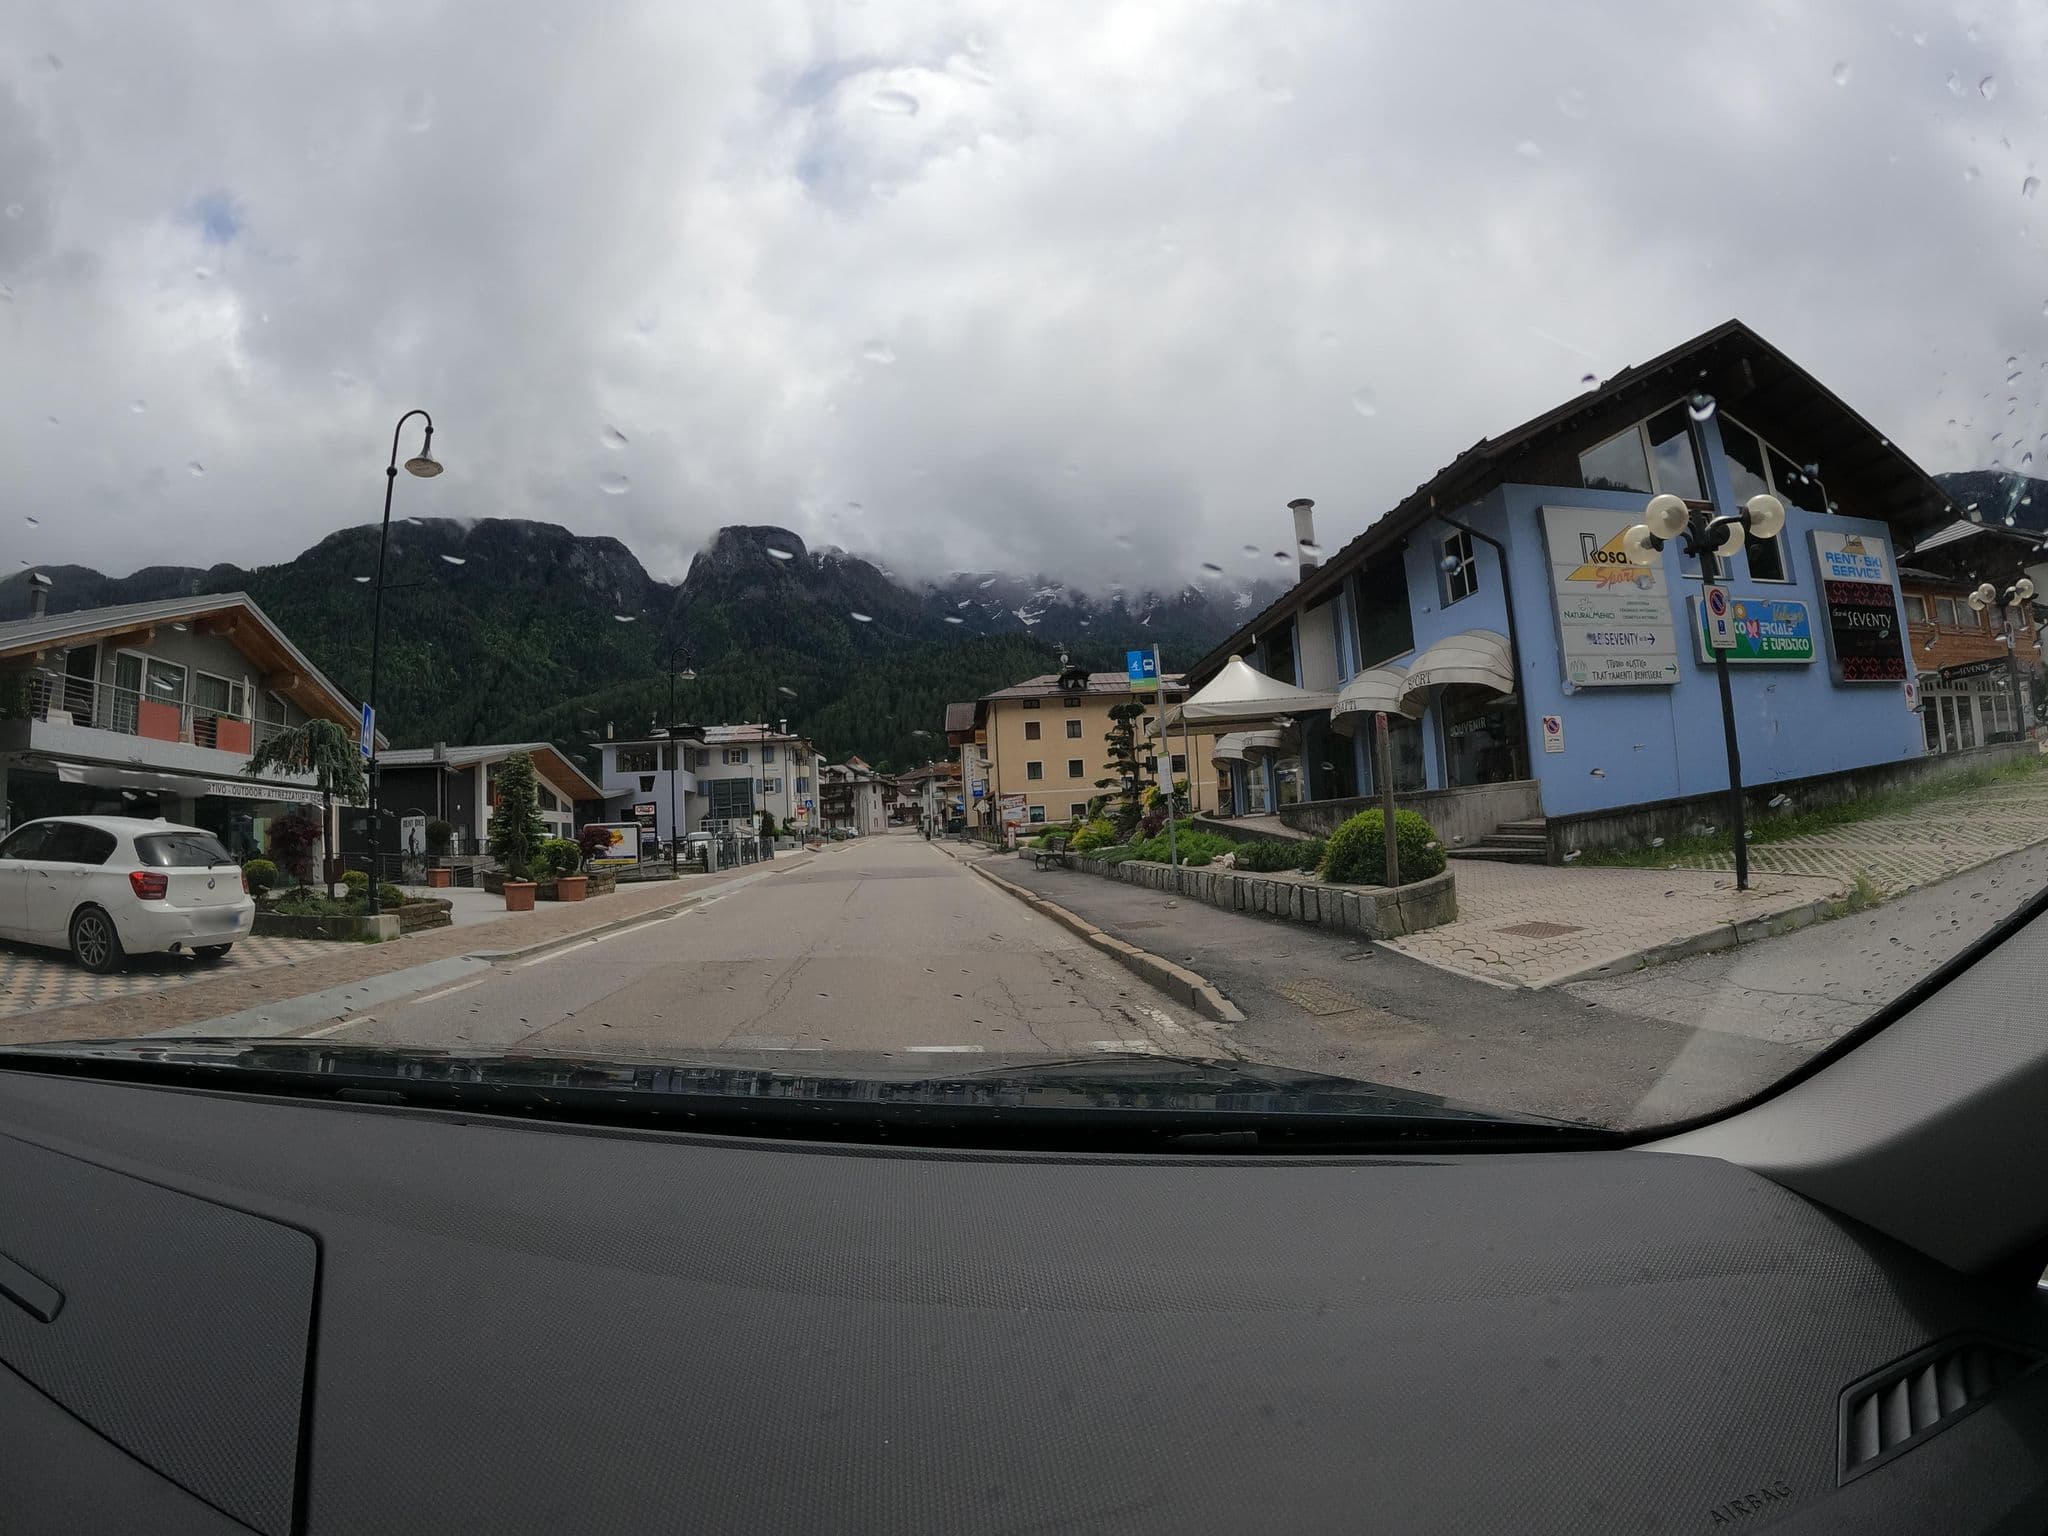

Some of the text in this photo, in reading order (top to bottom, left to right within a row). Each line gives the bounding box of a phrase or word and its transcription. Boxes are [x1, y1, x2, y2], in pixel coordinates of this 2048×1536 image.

[1825, 551, 1883, 568] RENT SKI
[1831, 565, 1880, 578] SERVICE
[1847, 610, 1892, 628] SEVENTY
[1603, 632, 1639, 646] SEVENTY
[1762, 637, 1810, 651] E TURISTICO
[206, 783, 227, 794] RTIVO
[232, 785, 263, 797] OUTDOOR
[1710, 1480, 1793, 1525] AIRBAG
